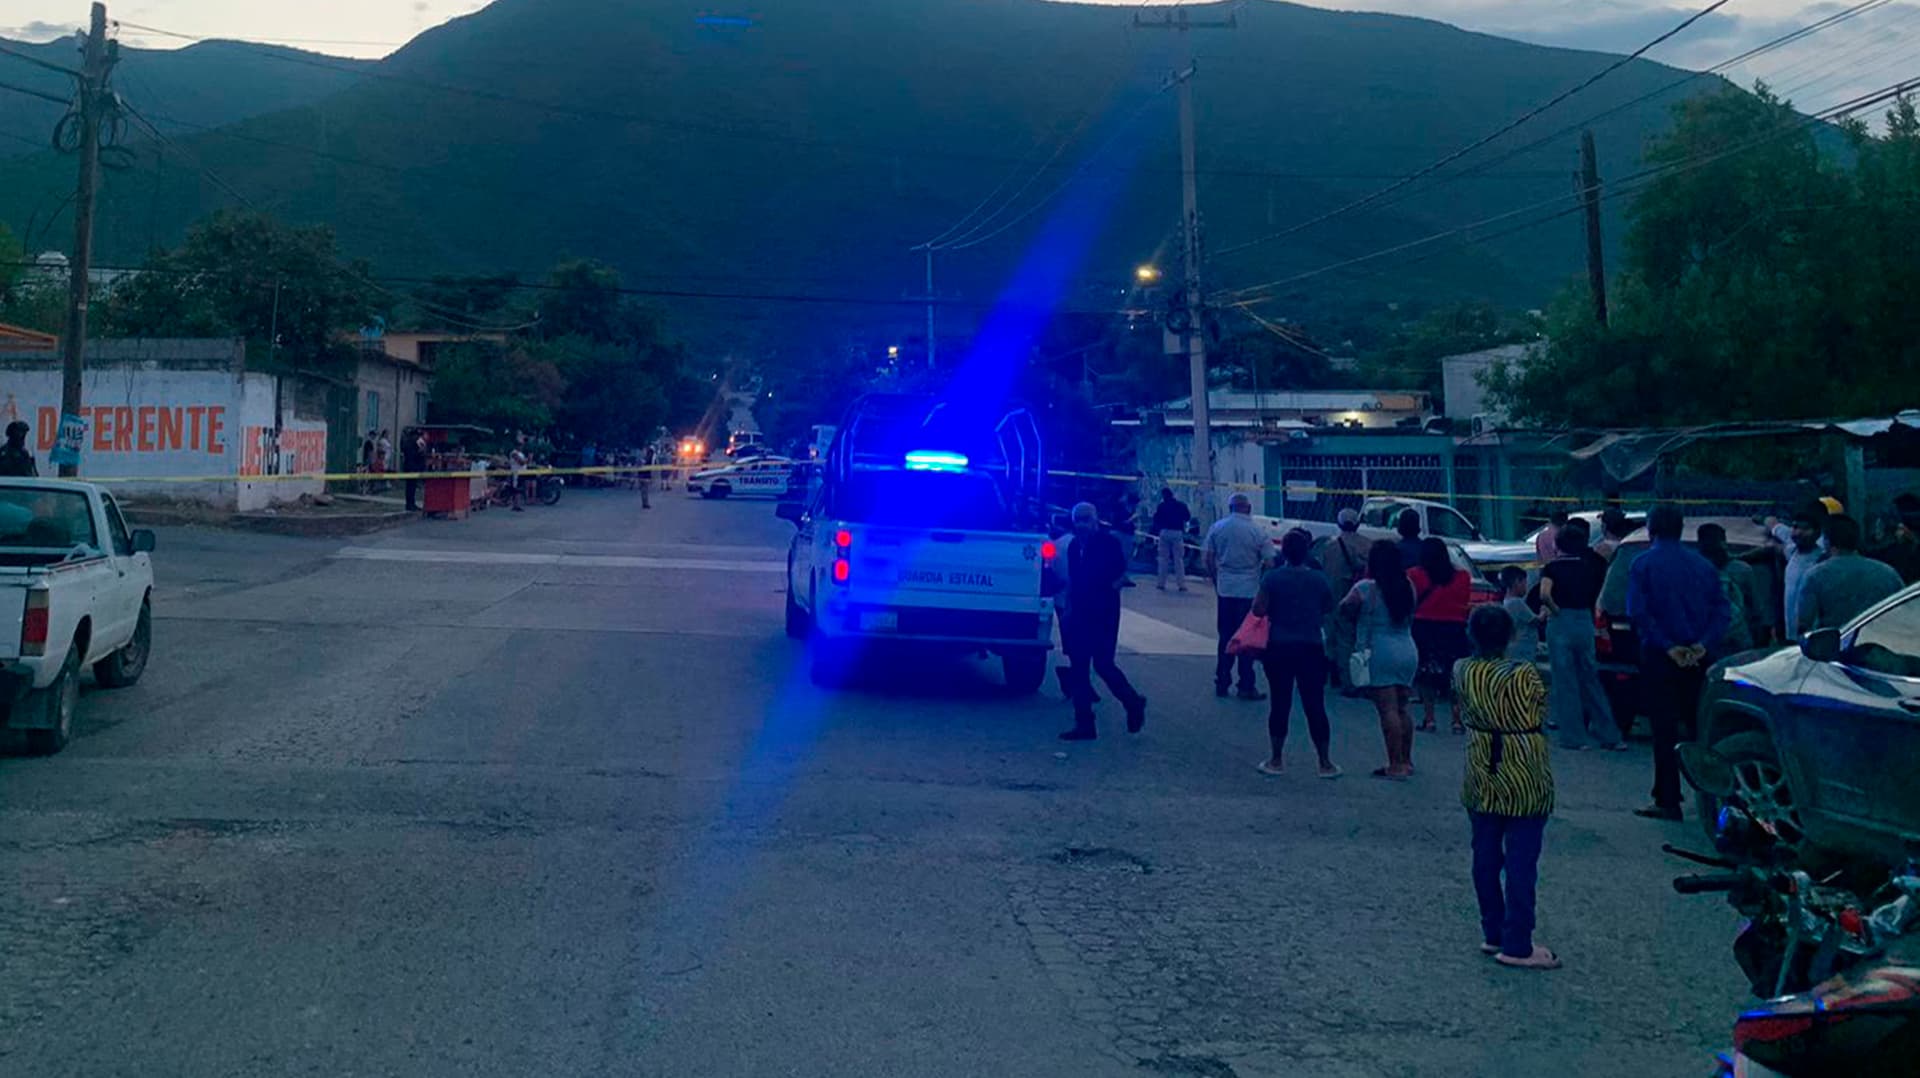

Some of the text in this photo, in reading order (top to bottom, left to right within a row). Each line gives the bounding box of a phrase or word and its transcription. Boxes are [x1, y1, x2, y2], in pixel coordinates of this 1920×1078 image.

[36, 405, 226, 455] DERENTE
[898, 569, 994, 587] GUARDIA ESTATAL
